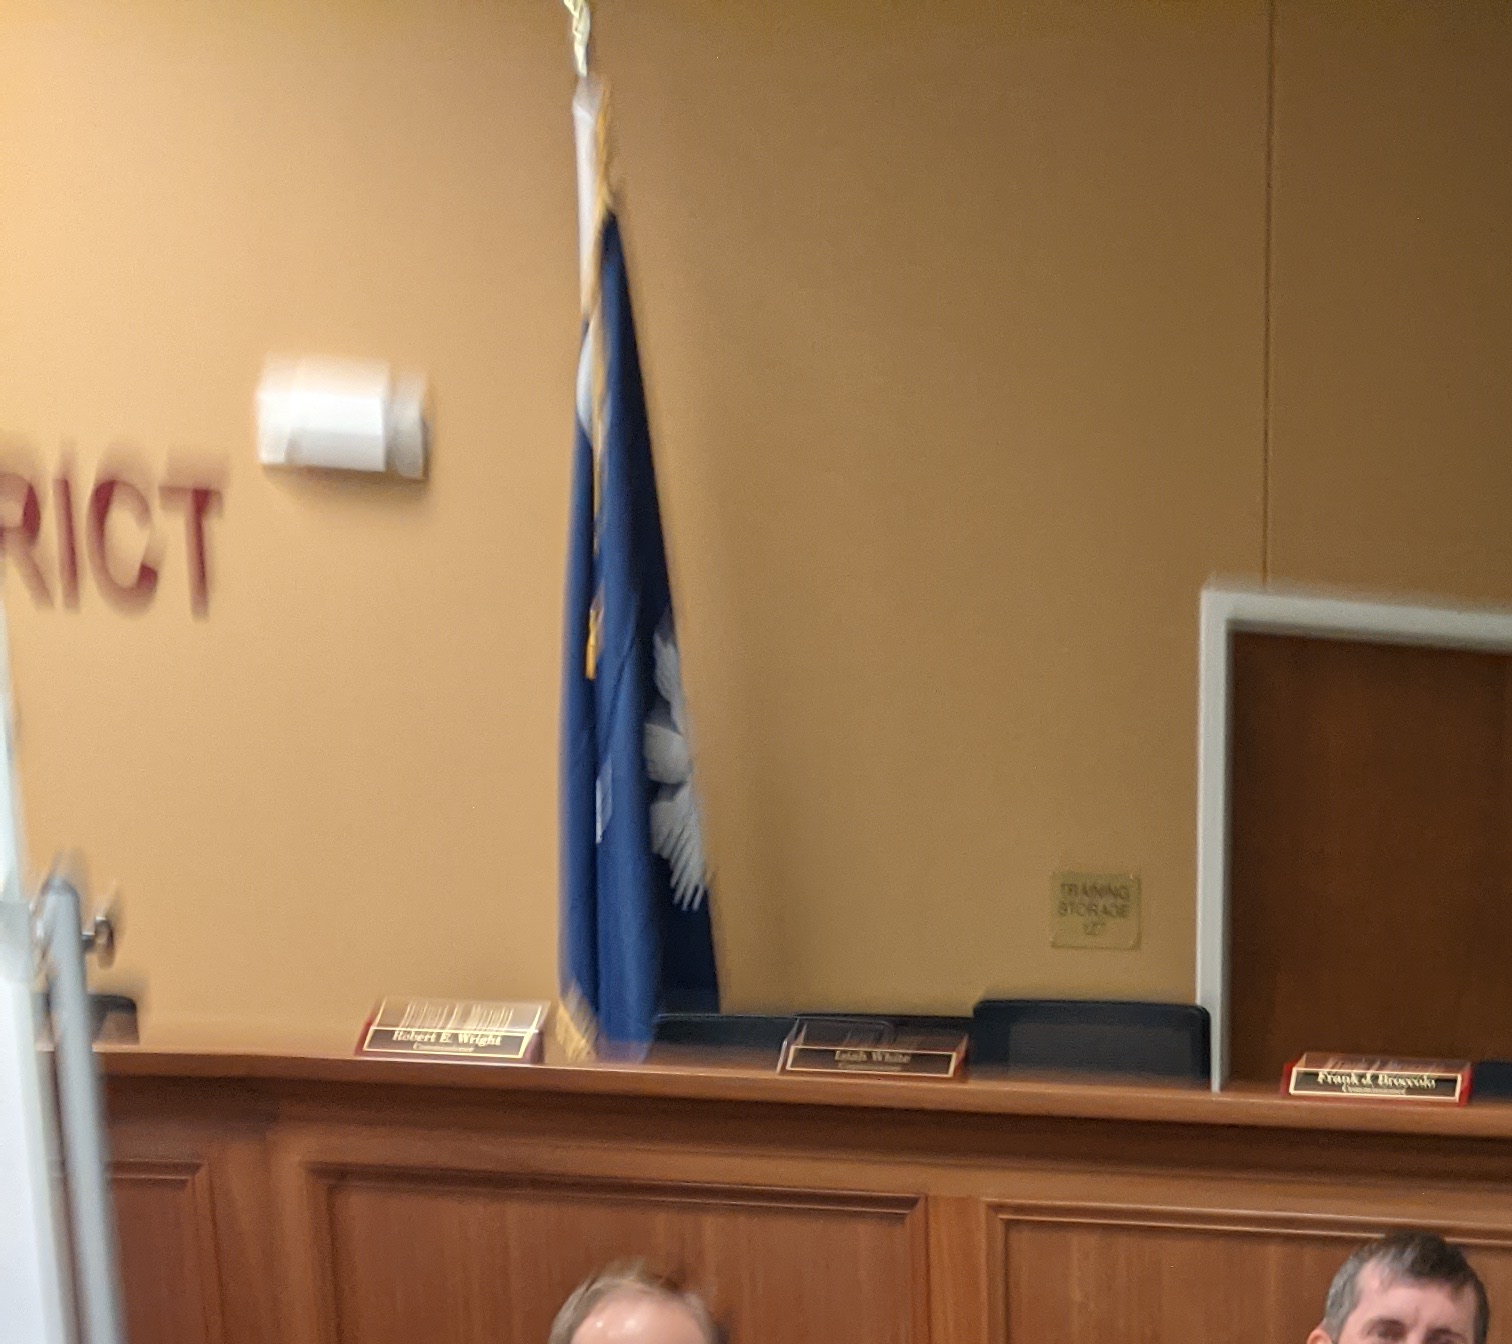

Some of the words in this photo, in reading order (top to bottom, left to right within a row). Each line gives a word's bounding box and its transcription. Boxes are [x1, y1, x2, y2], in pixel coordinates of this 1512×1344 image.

[392, 1029, 436, 1043] Robert
[457, 1032, 503, 1047] Wright
[1316, 1072, 1359, 1085] Frank
